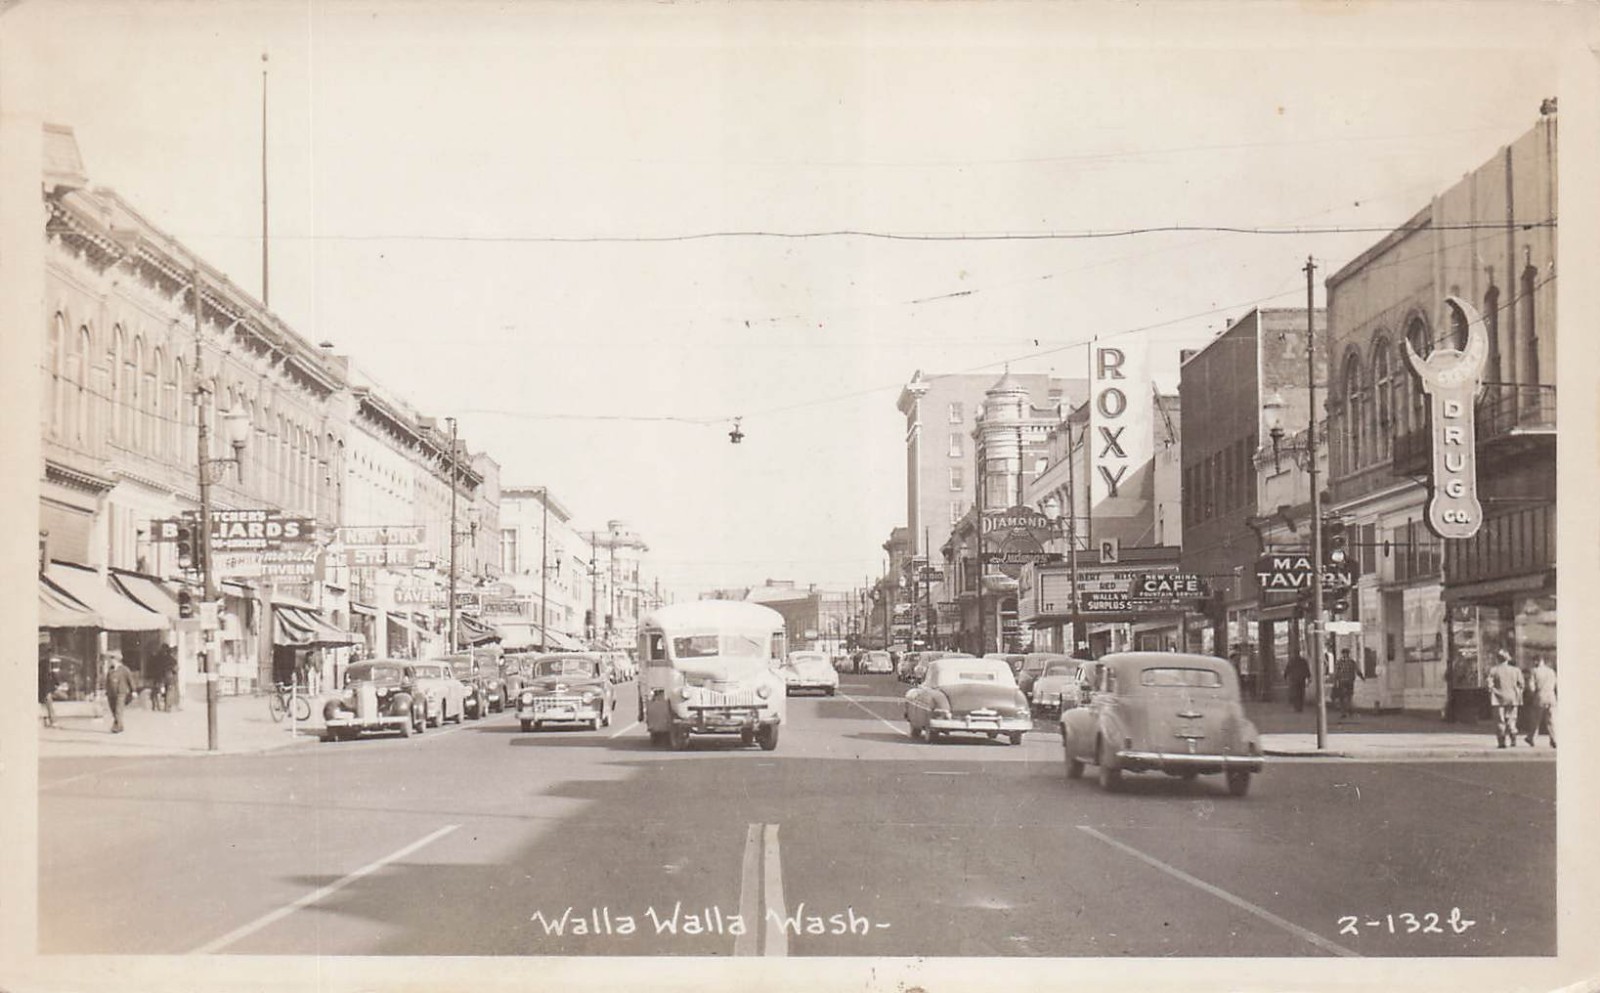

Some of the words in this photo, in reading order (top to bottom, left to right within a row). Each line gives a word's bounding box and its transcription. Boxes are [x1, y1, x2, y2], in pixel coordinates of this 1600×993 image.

[1097, 348, 1127, 498] ROXY
[1443, 400, 1466, 498] DRUG
[1443, 509, 1472, 524] CO.
[162, 522, 300, 538] BIARDS
[982, 517, 1047, 535] DIAMOND
[1103, 542, 1116, 560] R
[262, 564, 316, 575] TAVERN
[1067, 573, 1100, 581] RBERT
[1144, 580, 1198, 592] CAFE
[1087, 601, 1125, 610] SURPLUS
